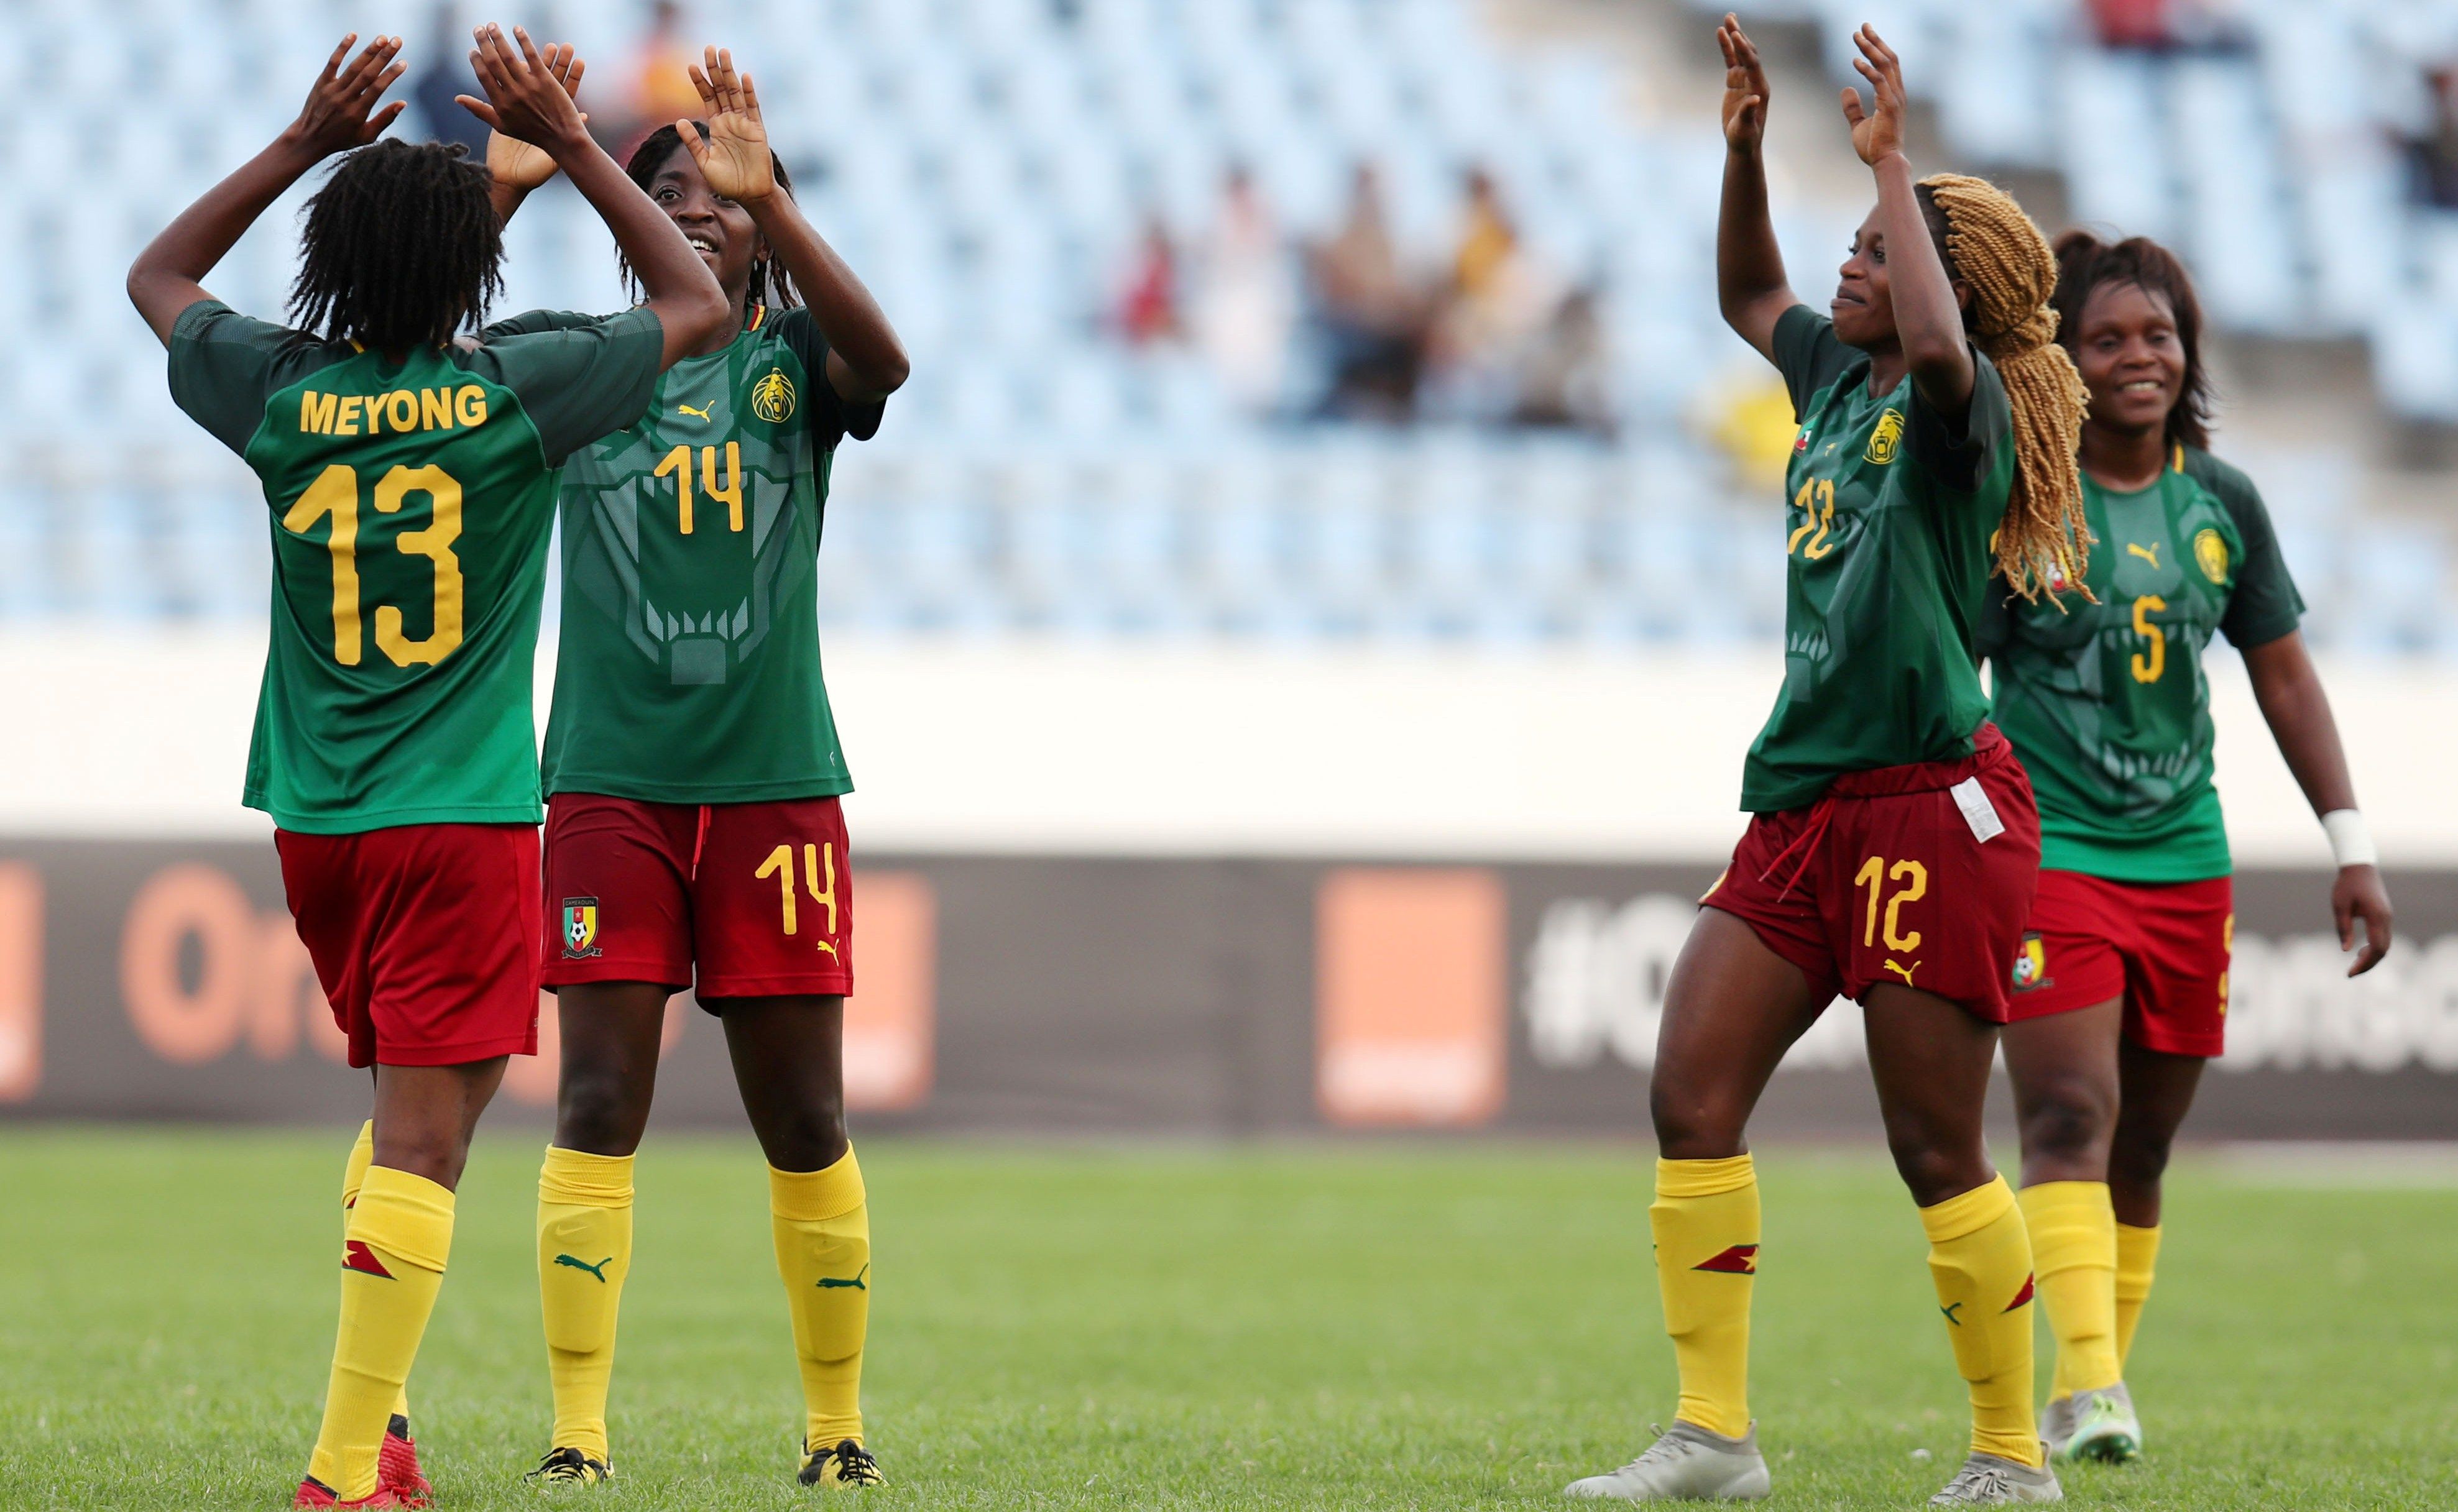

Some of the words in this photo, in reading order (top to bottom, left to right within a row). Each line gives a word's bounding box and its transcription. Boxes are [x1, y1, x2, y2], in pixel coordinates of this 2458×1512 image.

[300, 385, 487, 435] MEYONG
[653, 441, 744, 534] 14
[1787, 477, 1834, 560] 12
[283, 464, 464, 667] 13
[2131, 594, 2166, 684] 5
[755, 842, 837, 935] 14
[1854, 856, 1928, 953] 12
